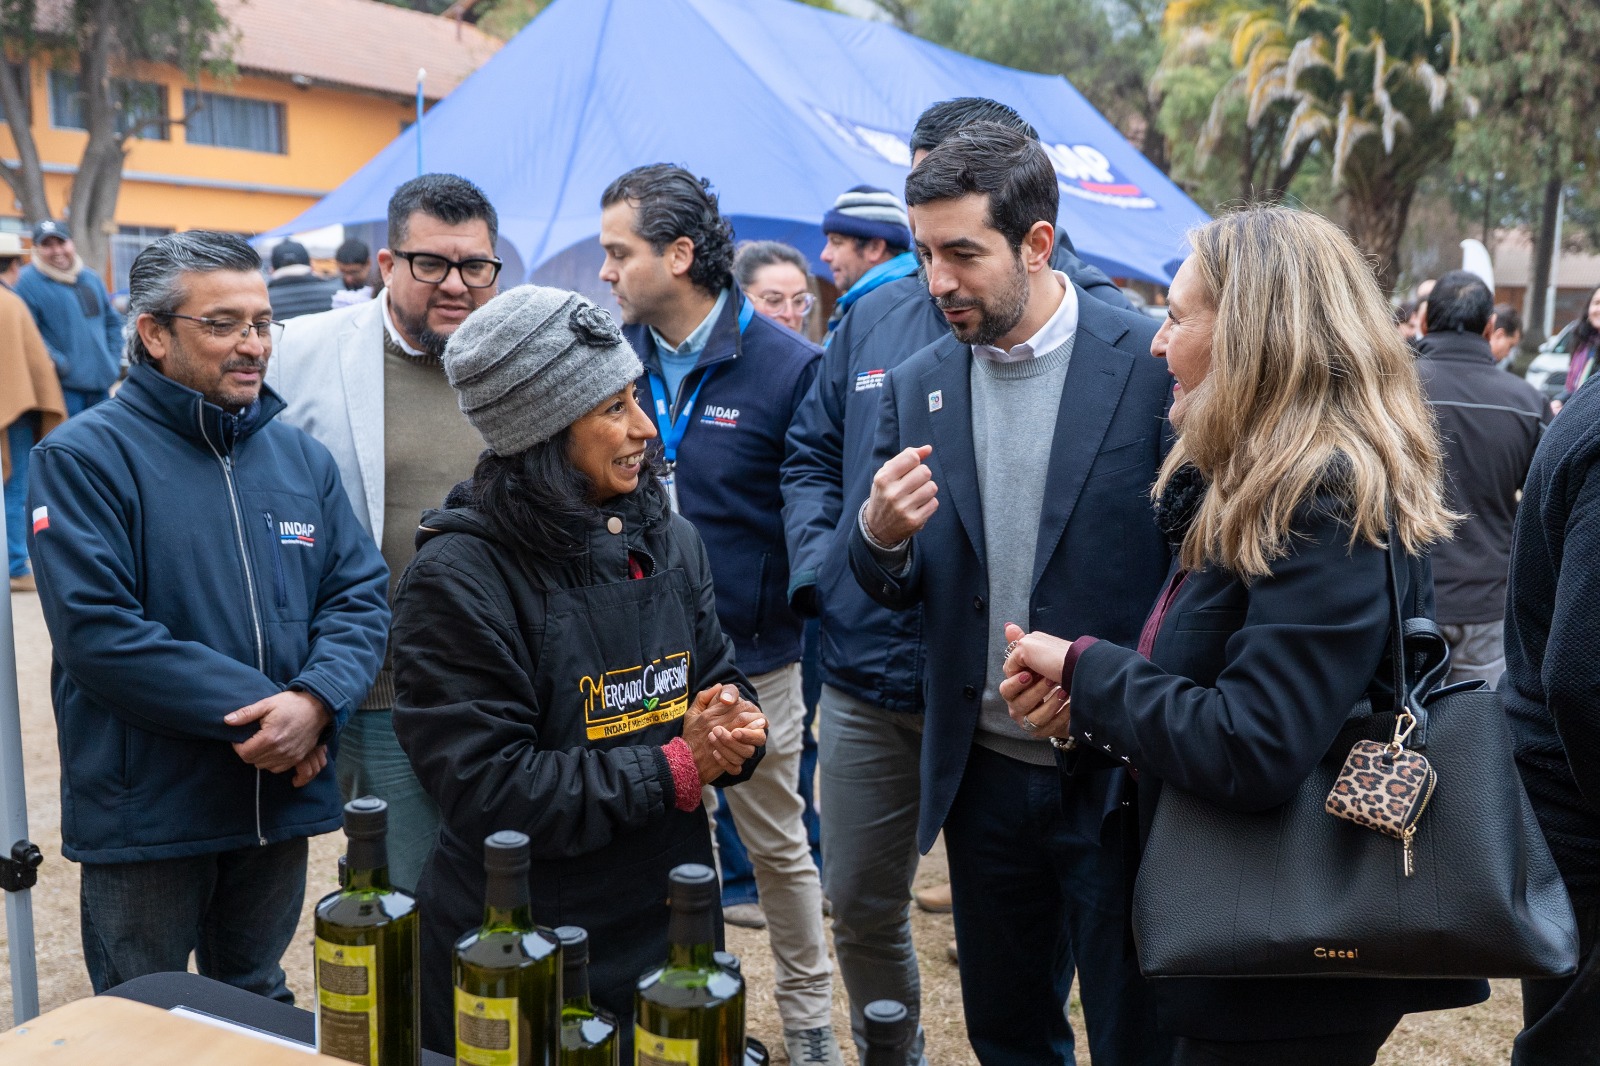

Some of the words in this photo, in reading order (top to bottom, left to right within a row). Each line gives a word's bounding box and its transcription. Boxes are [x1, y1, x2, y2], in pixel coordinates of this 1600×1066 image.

[704, 404, 740, 420] INDAP
[279, 521, 315, 537] INDAP
[604, 722, 627, 736] INDAP
